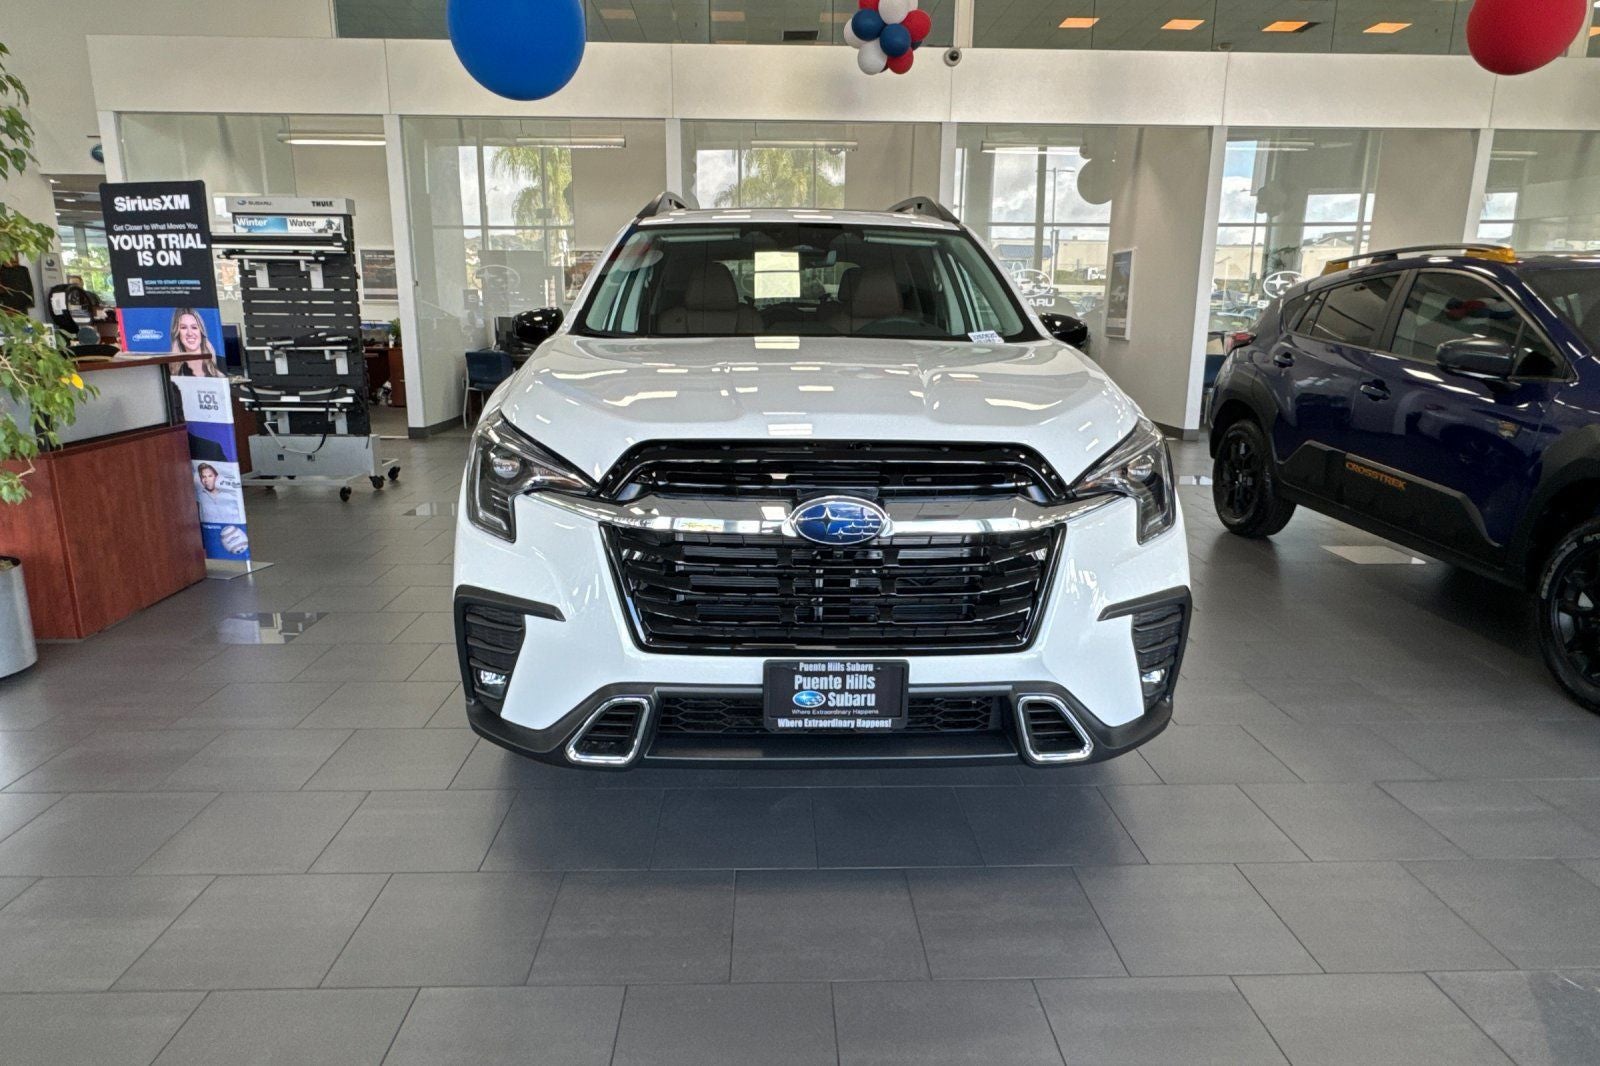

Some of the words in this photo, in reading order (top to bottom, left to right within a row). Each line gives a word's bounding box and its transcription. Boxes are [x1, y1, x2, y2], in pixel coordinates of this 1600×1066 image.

[114, 194, 190, 212] SiriusXM
[166, 222, 186, 230] Moves
[236, 217, 268, 227] Winter
[288, 219, 316, 227] Water
[108, 233, 156, 251] YOUR
[156, 233, 207, 250] TRIAL
[137, 250, 154, 267] IS
[156, 250, 182, 266] ON
[1027, 298, 1055, 307] ARU
[197, 394, 218, 404] LOL
[1345, 461, 1407, 490] CROSSTREK
[799, 662, 827, 672] Puente
[827, 662, 845, 672] Hills
[845, 662, 874, 672] Subaru
[794, 674, 843, 690] Puente
[845, 673, 876, 690] Hills
[827, 691, 876, 707] Subaru
[812, 708, 851, 716] Extraordinary
[777, 718, 803, 728] Where
[803, 718, 856, 729] Extraordinary
[856, 718, 892, 729] Happens!
